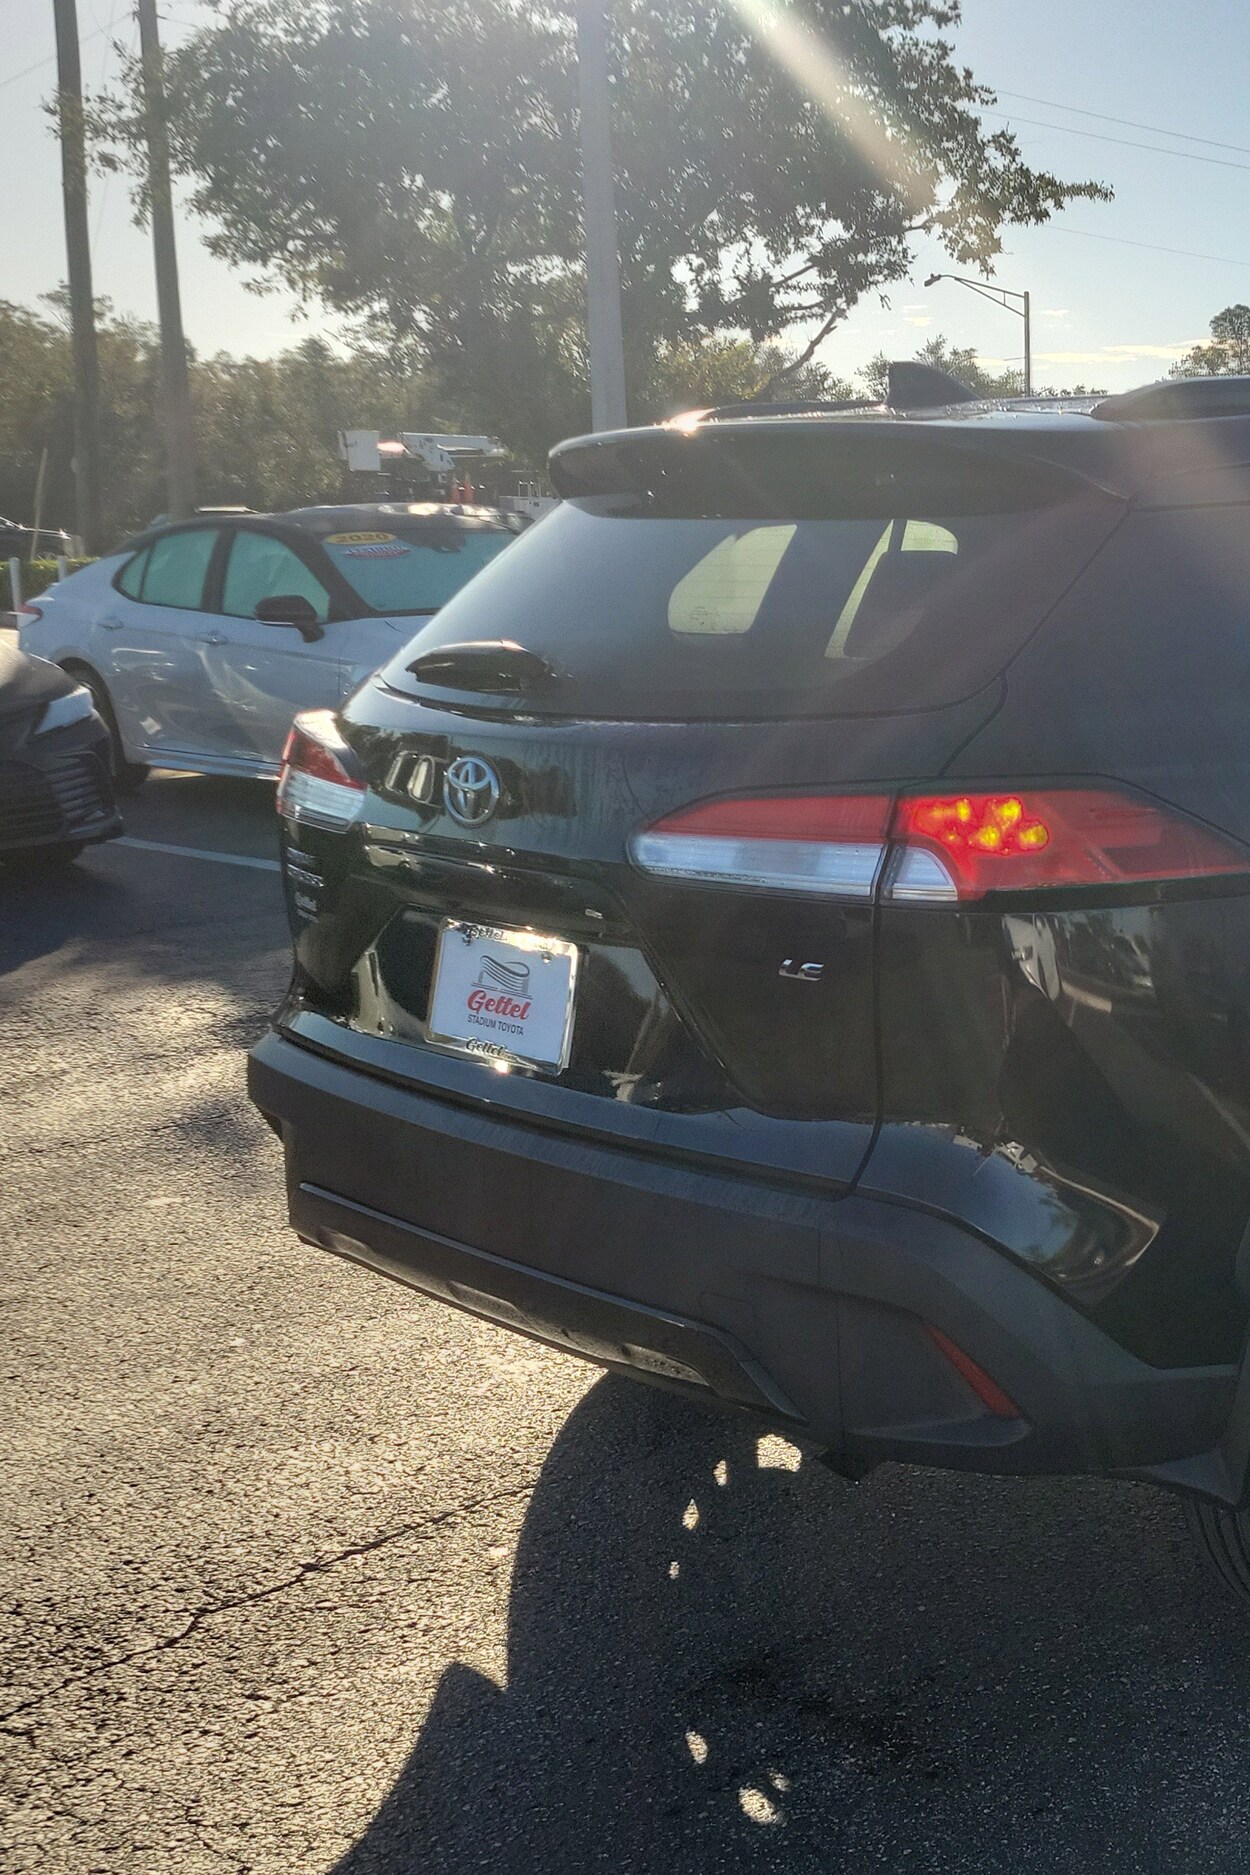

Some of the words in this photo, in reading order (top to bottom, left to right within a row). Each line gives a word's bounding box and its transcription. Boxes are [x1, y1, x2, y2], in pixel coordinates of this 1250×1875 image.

[335, 533, 389, 543] 2020
[779, 959, 824, 981] LE
[467, 989, 532, 1020] Gettel
[467, 1014, 496, 1029] STADIUM
[498, 1020, 524, 1036] TOYOTA
